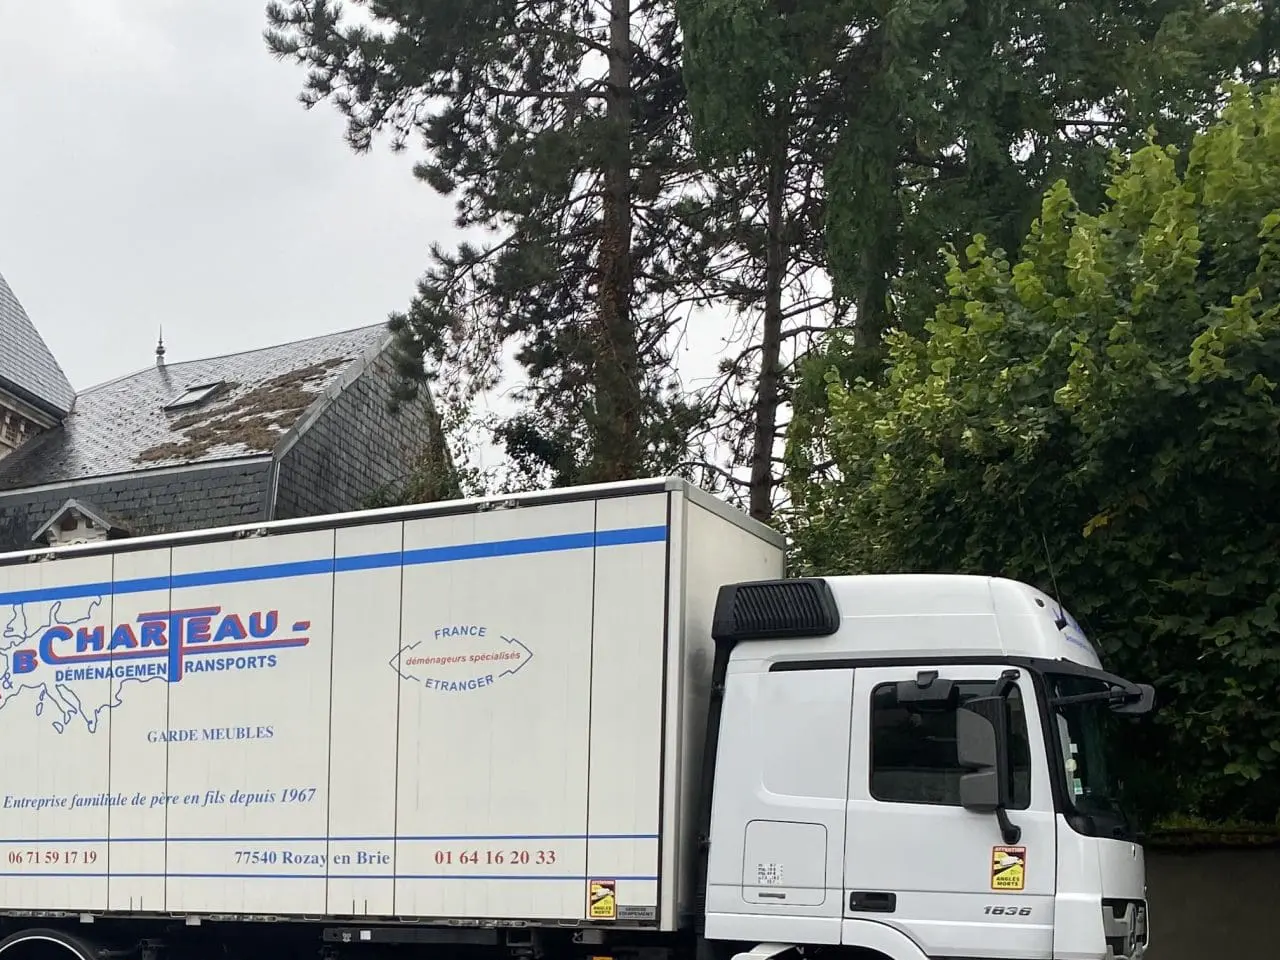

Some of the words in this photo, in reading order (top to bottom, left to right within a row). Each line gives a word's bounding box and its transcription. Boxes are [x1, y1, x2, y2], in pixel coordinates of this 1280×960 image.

[434, 625, 487, 640] FRANCE
[13, 649, 39, 675] B
[405, 655, 466, 667] déménageurs
[425, 674, 494, 692] ETRANGER
[147, 729, 198, 744] GARDE
[202, 725, 275, 741] MEUBLES
[2, 795, 68, 811] Entreprise
[68, 793, 128, 811] familiale
[131, 792, 146, 806] de
[149, 791, 179, 809] père
[183, 794, 200, 805] en
[201, 789, 226, 808] fils
[229, 788, 276, 807] depuis
[279, 787, 317, 803] 1967
[8, 851, 23, 864] 06
[26, 851, 41, 864] 71
[44, 851, 60, 864] 59
[64, 851, 78, 864] 17
[82, 851, 97, 864] 19
[234, 851, 277, 865] 77540
[282, 851, 327, 868] Rozay
[333, 853, 351, 865] en
[356, 850, 391, 865] Brie
[434, 850, 452, 865] 01
[459, 850, 479, 865] 64
[485, 850, 505, 865] 16
[510, 850, 530, 865] 20
[535, 850, 556, 865] 33
[984, 906, 1032, 916] 1836
